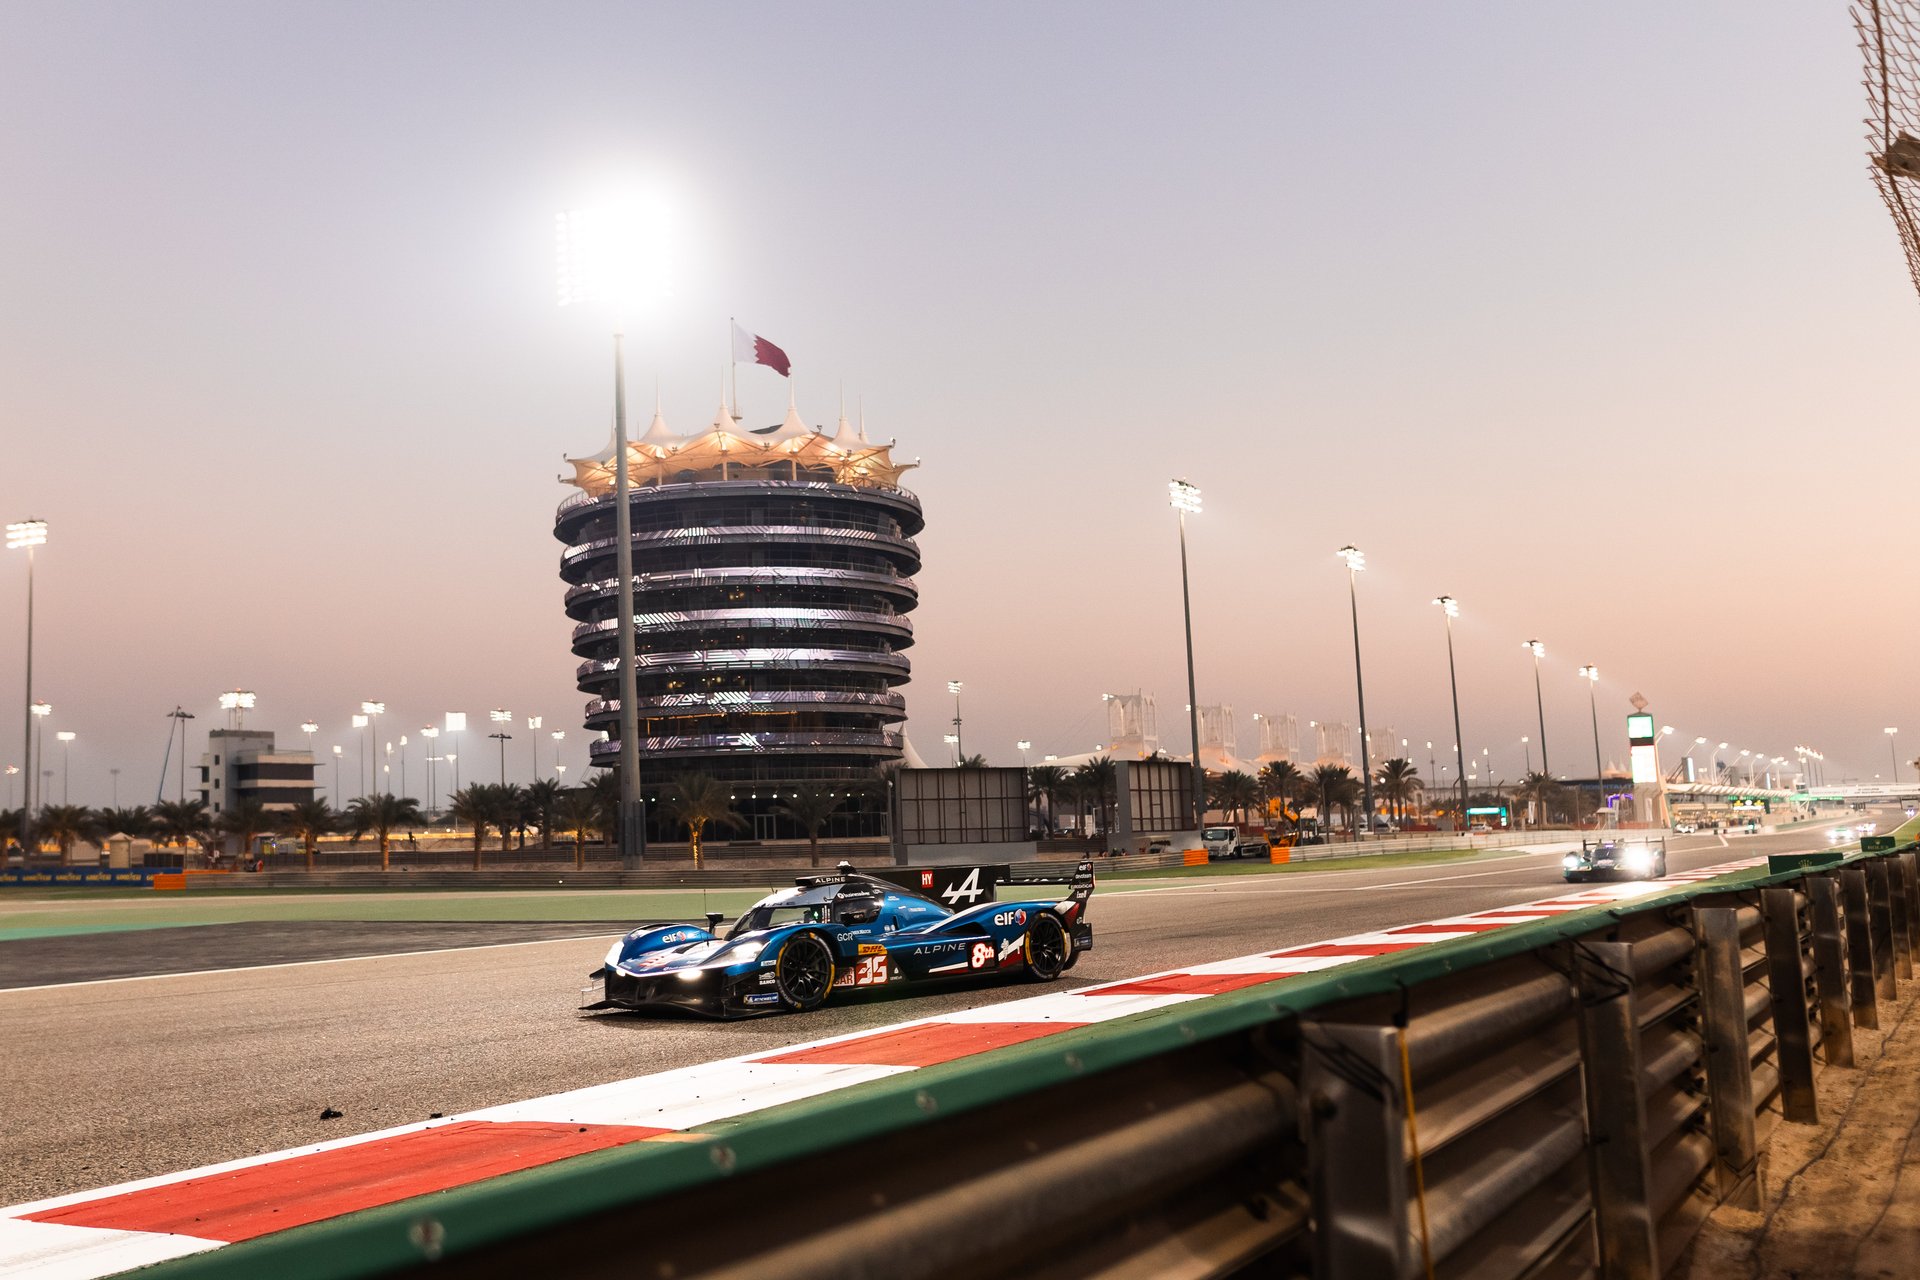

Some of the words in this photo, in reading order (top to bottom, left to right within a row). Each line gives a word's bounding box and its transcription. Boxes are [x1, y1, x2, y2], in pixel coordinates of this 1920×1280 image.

[922, 873, 932, 885] HY
[994, 912, 1014, 926] elf
[662, 934, 677, 943] elf
[837, 933, 853, 941] GCR
[862, 945, 883, 953] DHL
[914, 942, 966, 955] ALPINE
[972, 942, 994, 968] 8th
